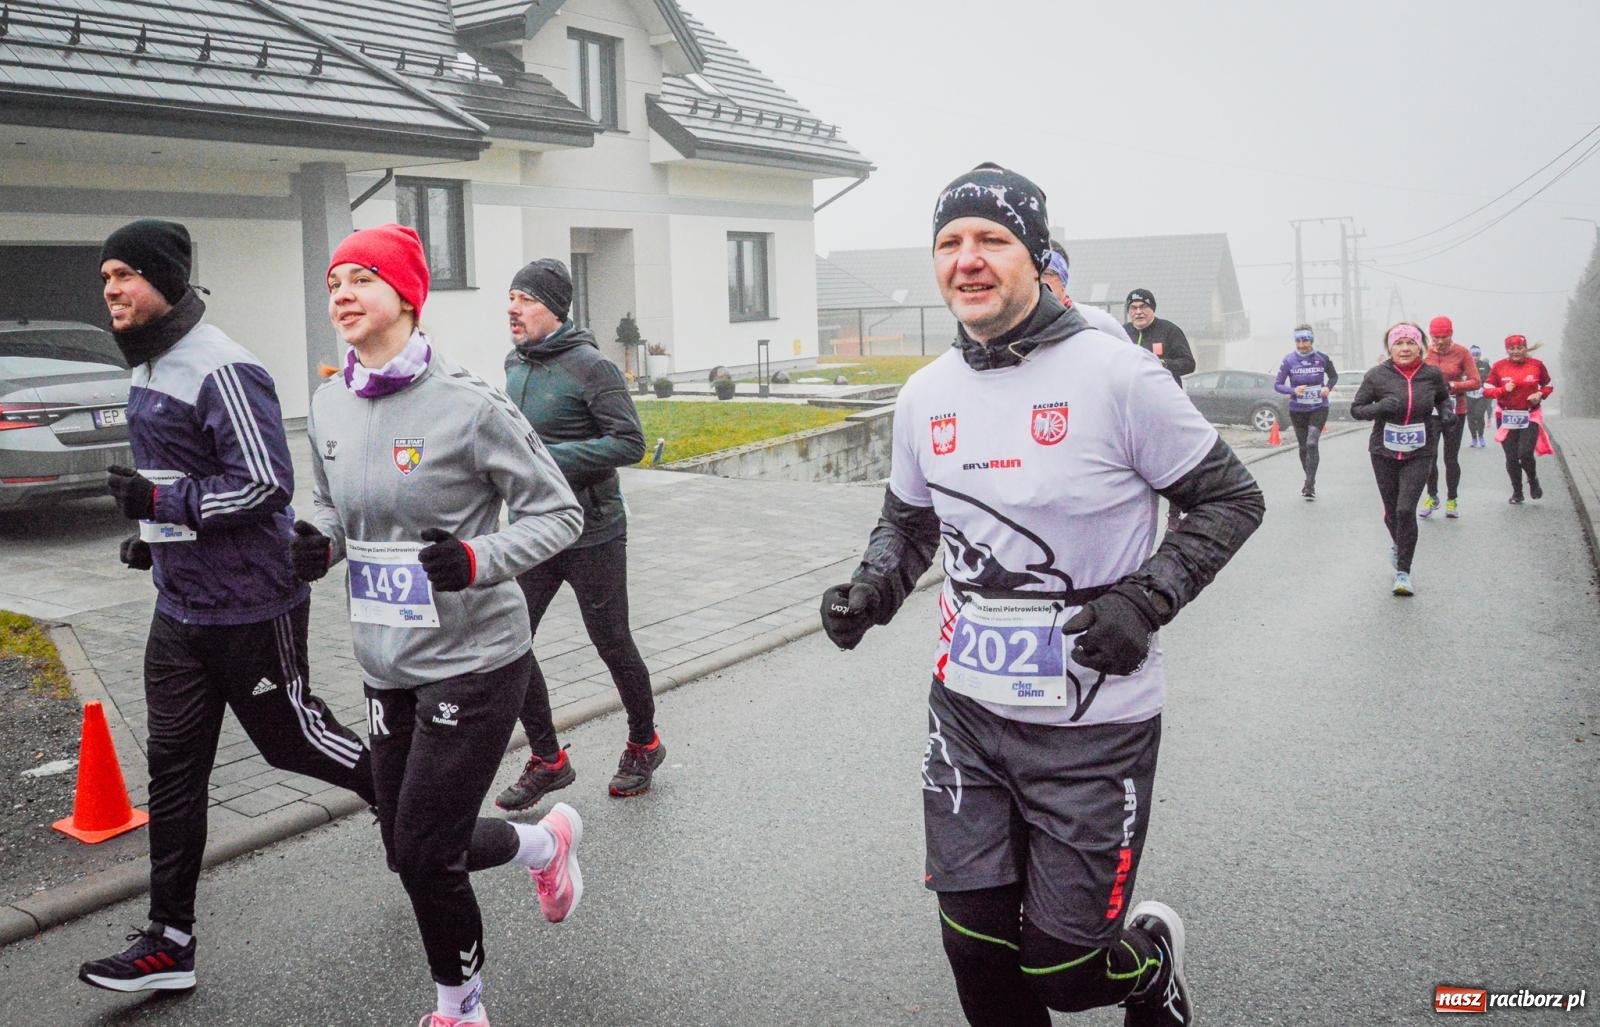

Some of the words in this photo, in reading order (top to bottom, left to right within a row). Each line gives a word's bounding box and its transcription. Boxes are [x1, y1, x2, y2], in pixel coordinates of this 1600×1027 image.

[930, 412, 957, 421] POLSKA
[1391, 432, 1419, 444] 132
[361, 564, 413, 602] 149
[982, 605, 1003, 613] Ziemi
[1003, 604, 1052, 614] Pietrowickiej
[958, 623, 1039, 673] 202
[432, 715, 459, 726] hummel
